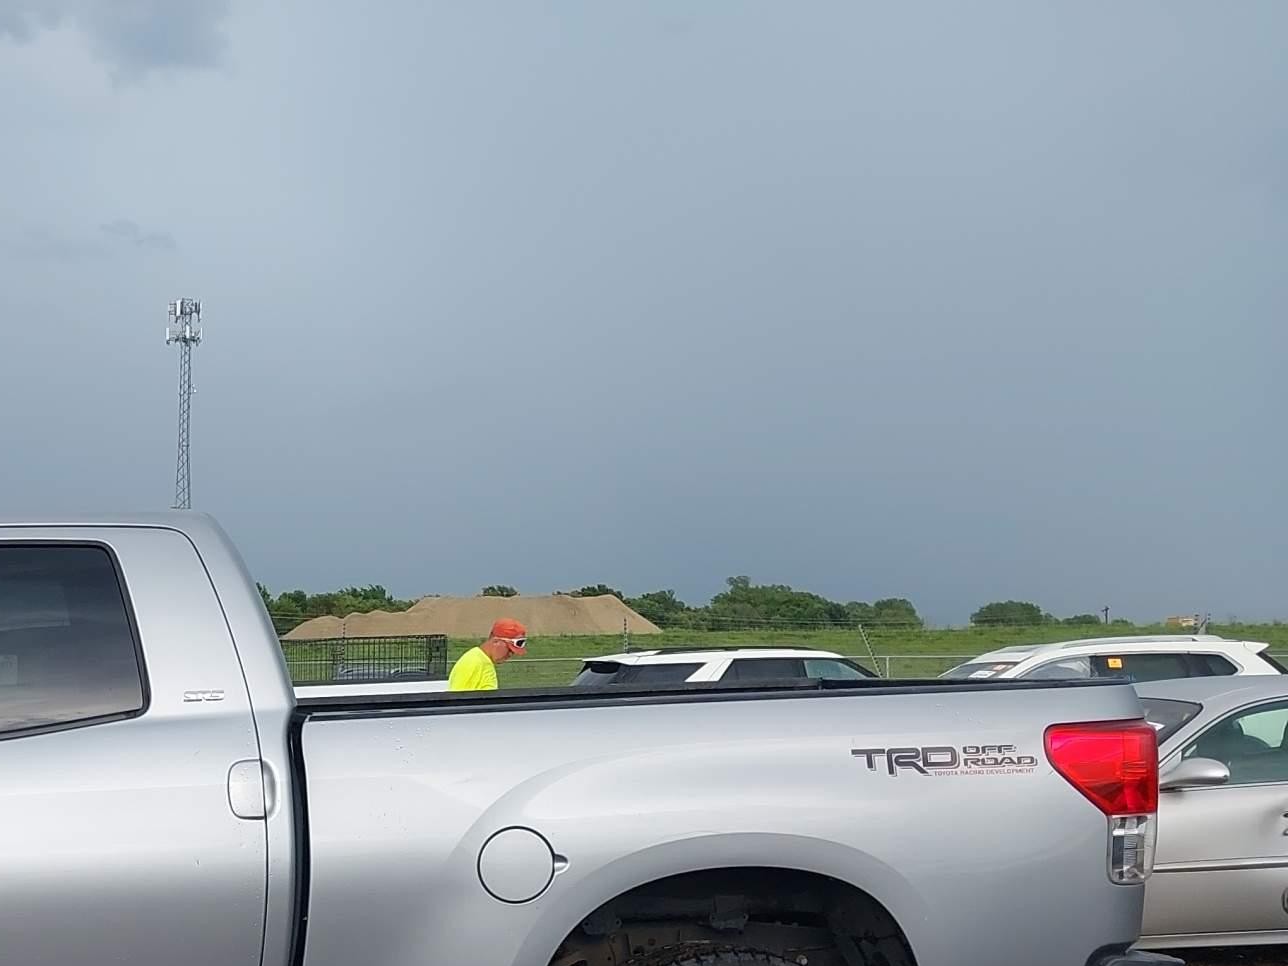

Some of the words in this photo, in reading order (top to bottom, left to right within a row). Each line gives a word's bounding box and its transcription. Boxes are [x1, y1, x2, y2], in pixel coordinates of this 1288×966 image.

[962, 744, 1017, 756] OFF
[851, 746, 960, 777] TRD
[963, 756, 1038, 768] ROAD
